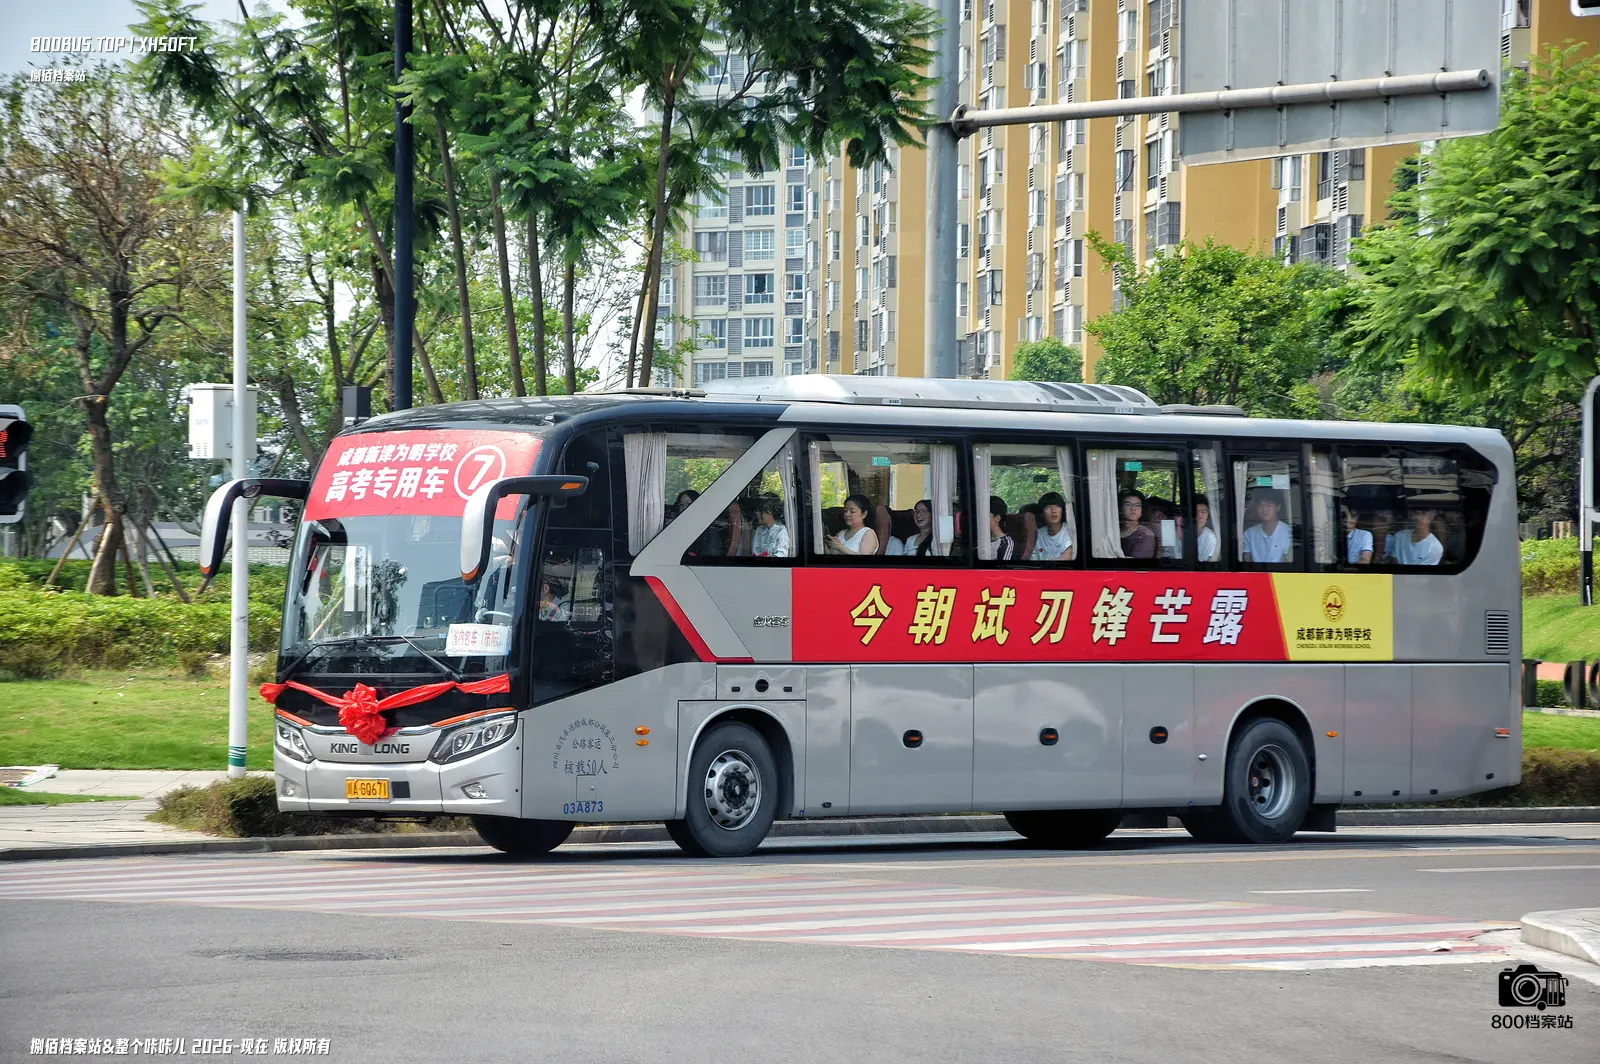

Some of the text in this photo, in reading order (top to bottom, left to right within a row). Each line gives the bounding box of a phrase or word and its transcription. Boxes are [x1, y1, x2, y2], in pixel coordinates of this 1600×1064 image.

[337, 443, 458, 467] 成都新津为明学校
[325, 466, 449, 503] 高考专用车
[850, 584, 1249, 646] 今朝试刃锋芒露
[1296, 627, 1372, 641] 成都新津为明学校
[330, 743, 410, 754] KING LONG
[572, 737, 602, 750] 公路客运
[563, 759, 608, 775] 核载50人
[563, 800, 604, 815] 03A873
